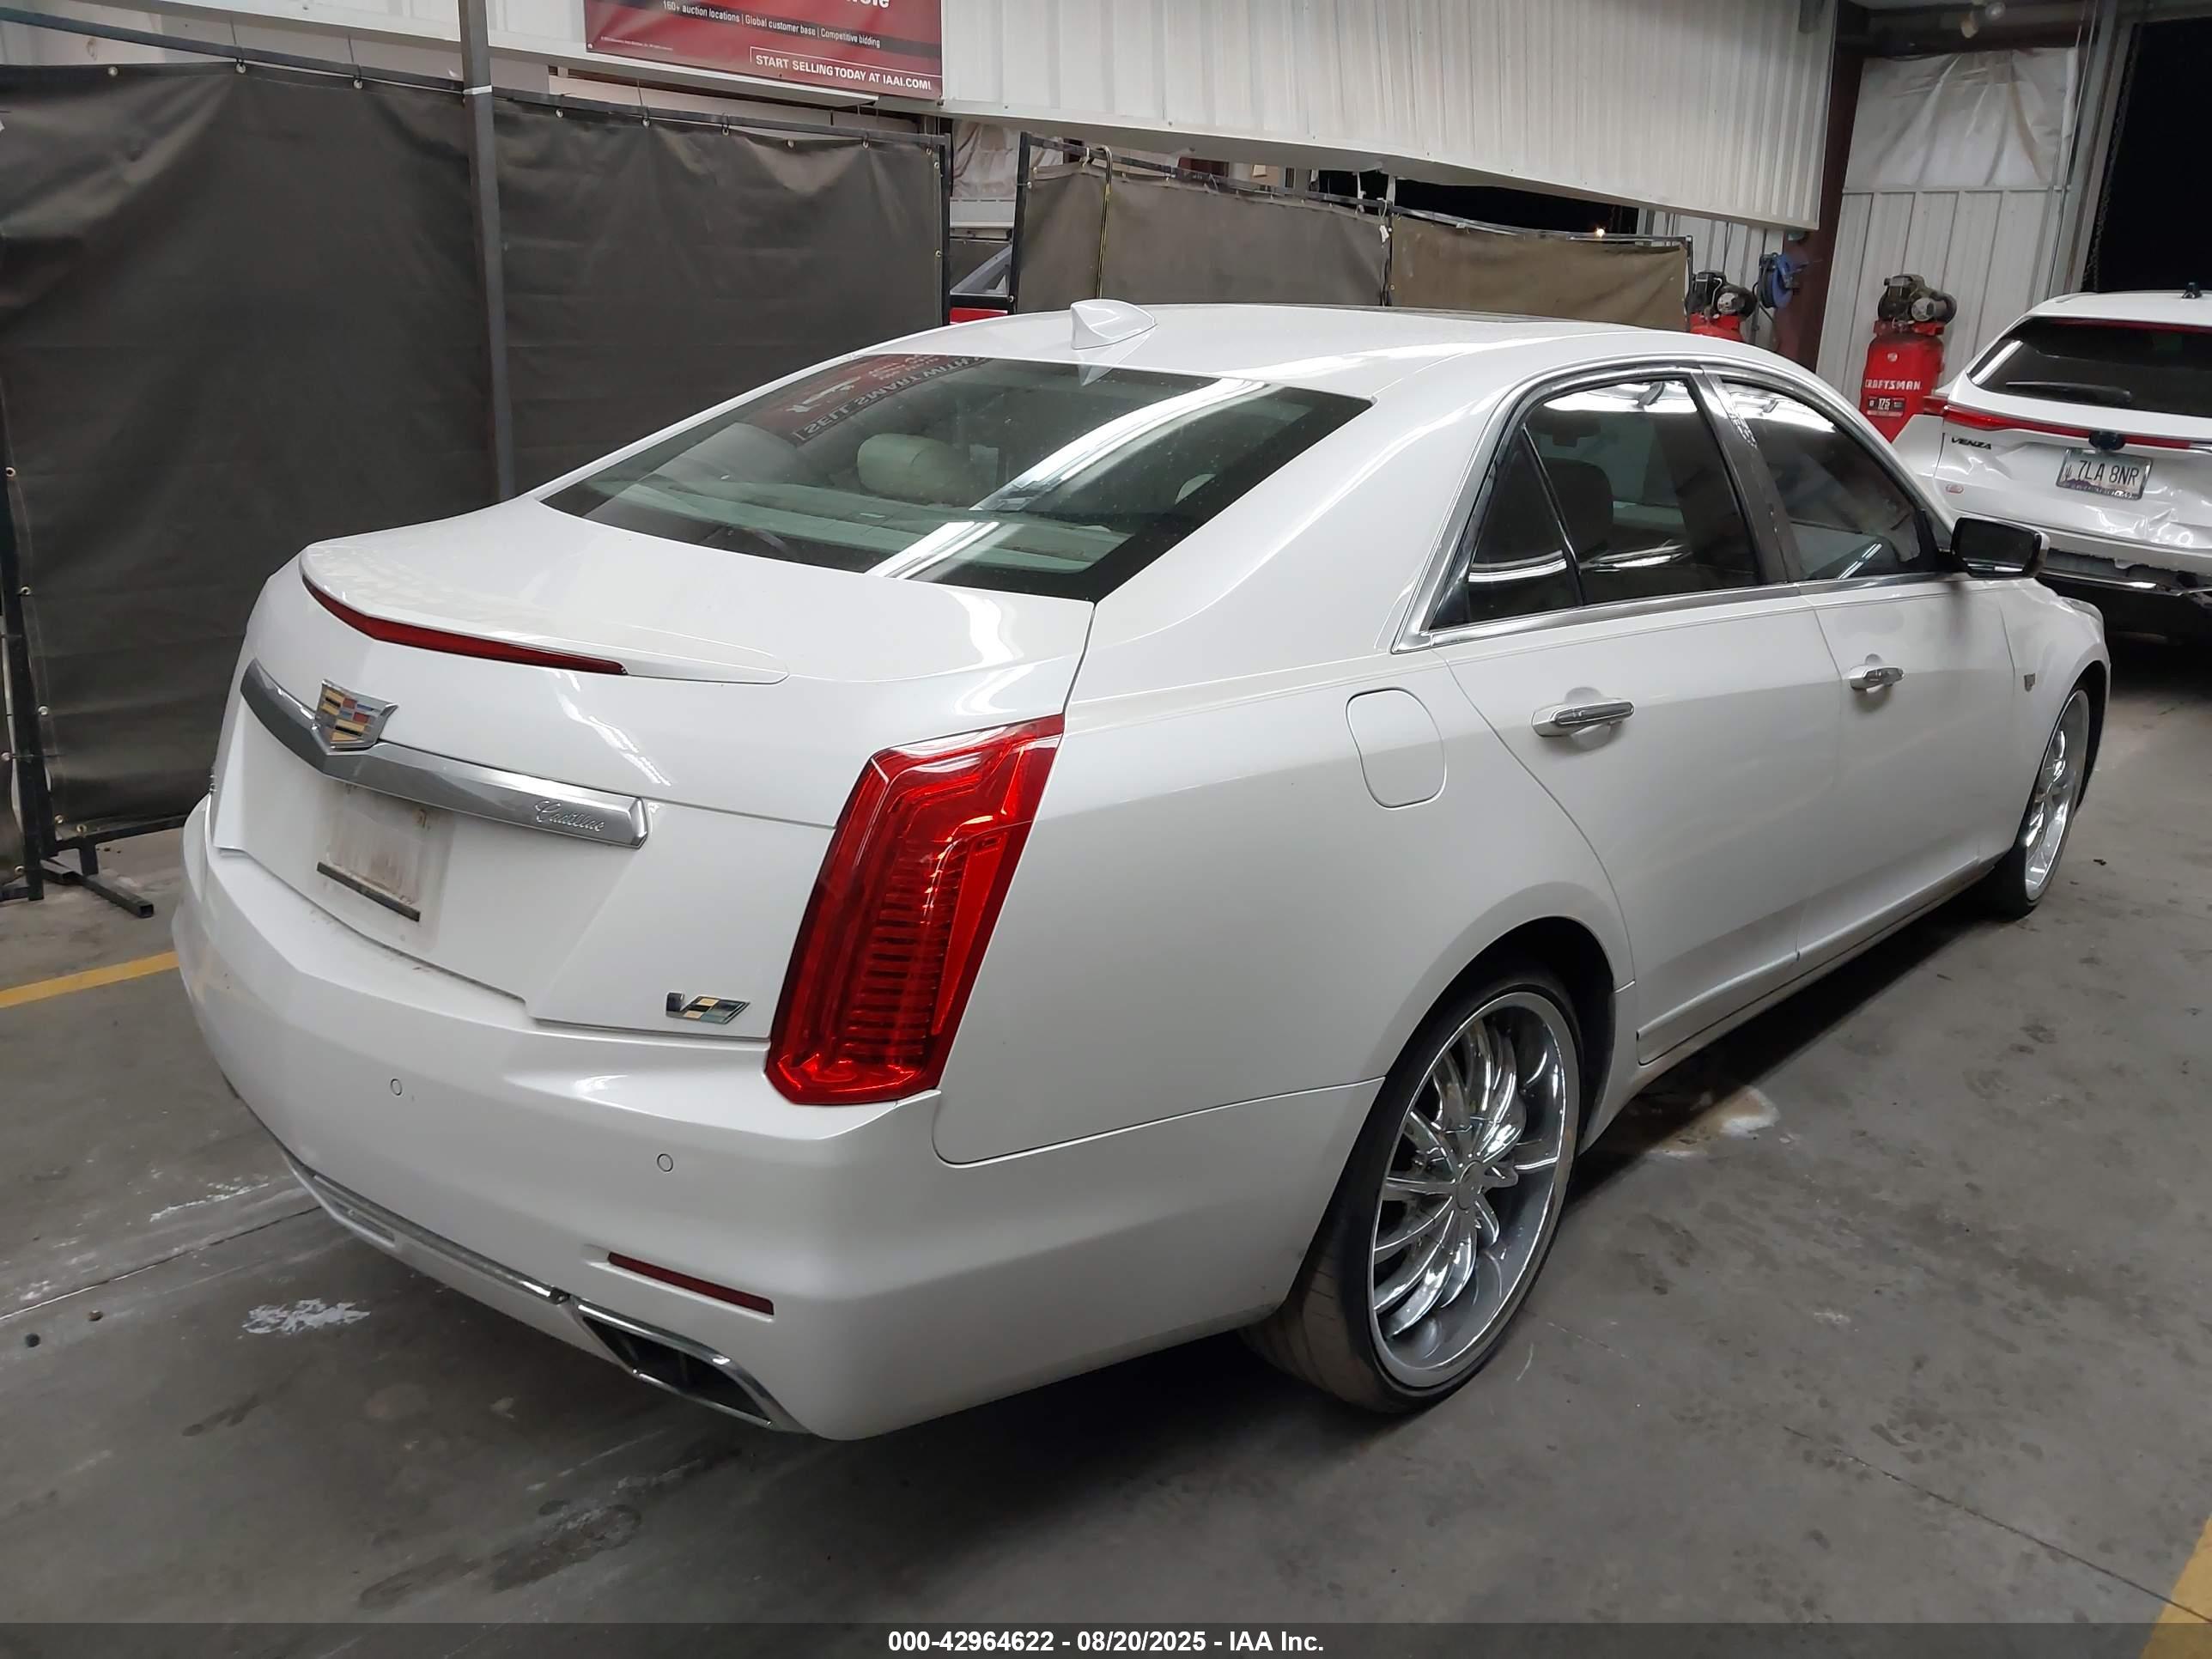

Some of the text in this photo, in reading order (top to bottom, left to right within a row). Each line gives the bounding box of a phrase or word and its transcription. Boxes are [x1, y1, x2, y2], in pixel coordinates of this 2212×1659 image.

[682, 4, 708, 17] auction
[708, 8, 740, 22] locations
[745, 15, 767, 27] Global
[769, 20, 799, 33] customer
[799, 24, 816, 36] base
[821, 27, 858, 43] Competitive
[859, 34, 881, 48] bidding
[756, 55, 789, 69] START
[792, 61, 833, 76] SELLING
[835, 66, 866, 81] TODAY
[868, 72, 881, 83] AT
[1864, 379, 1921, 391] CRAFTSMAN
[1951, 437, 1991, 450] VENZA
[2078, 459, 2140, 486] 7LA 8NR
[535, 799, 605, 832] Cadillac
